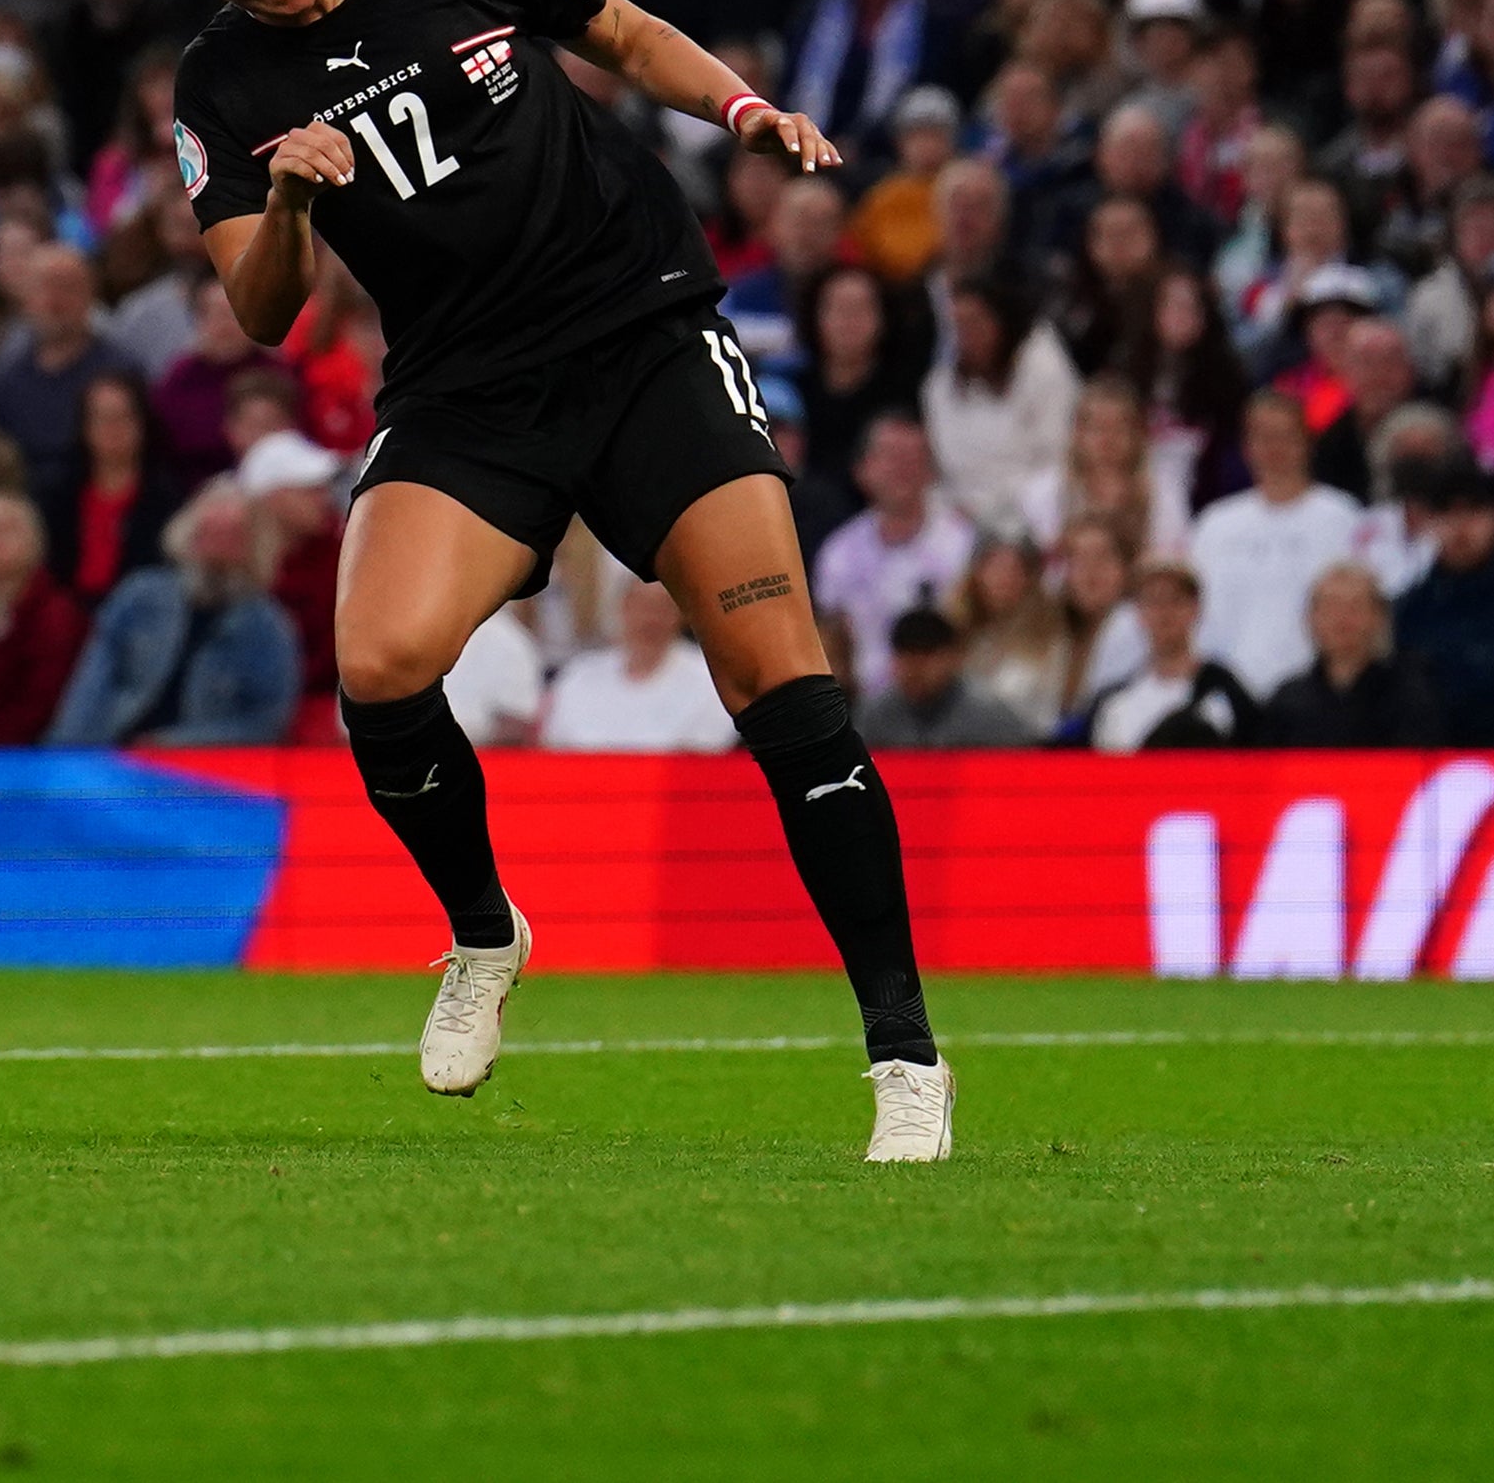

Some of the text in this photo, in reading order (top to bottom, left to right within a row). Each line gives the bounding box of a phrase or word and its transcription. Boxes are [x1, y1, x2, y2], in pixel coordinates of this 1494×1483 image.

[312, 62, 423, 124] ÖSTERREICH
[349, 91, 461, 201] 12
[701, 329, 769, 423] 12
